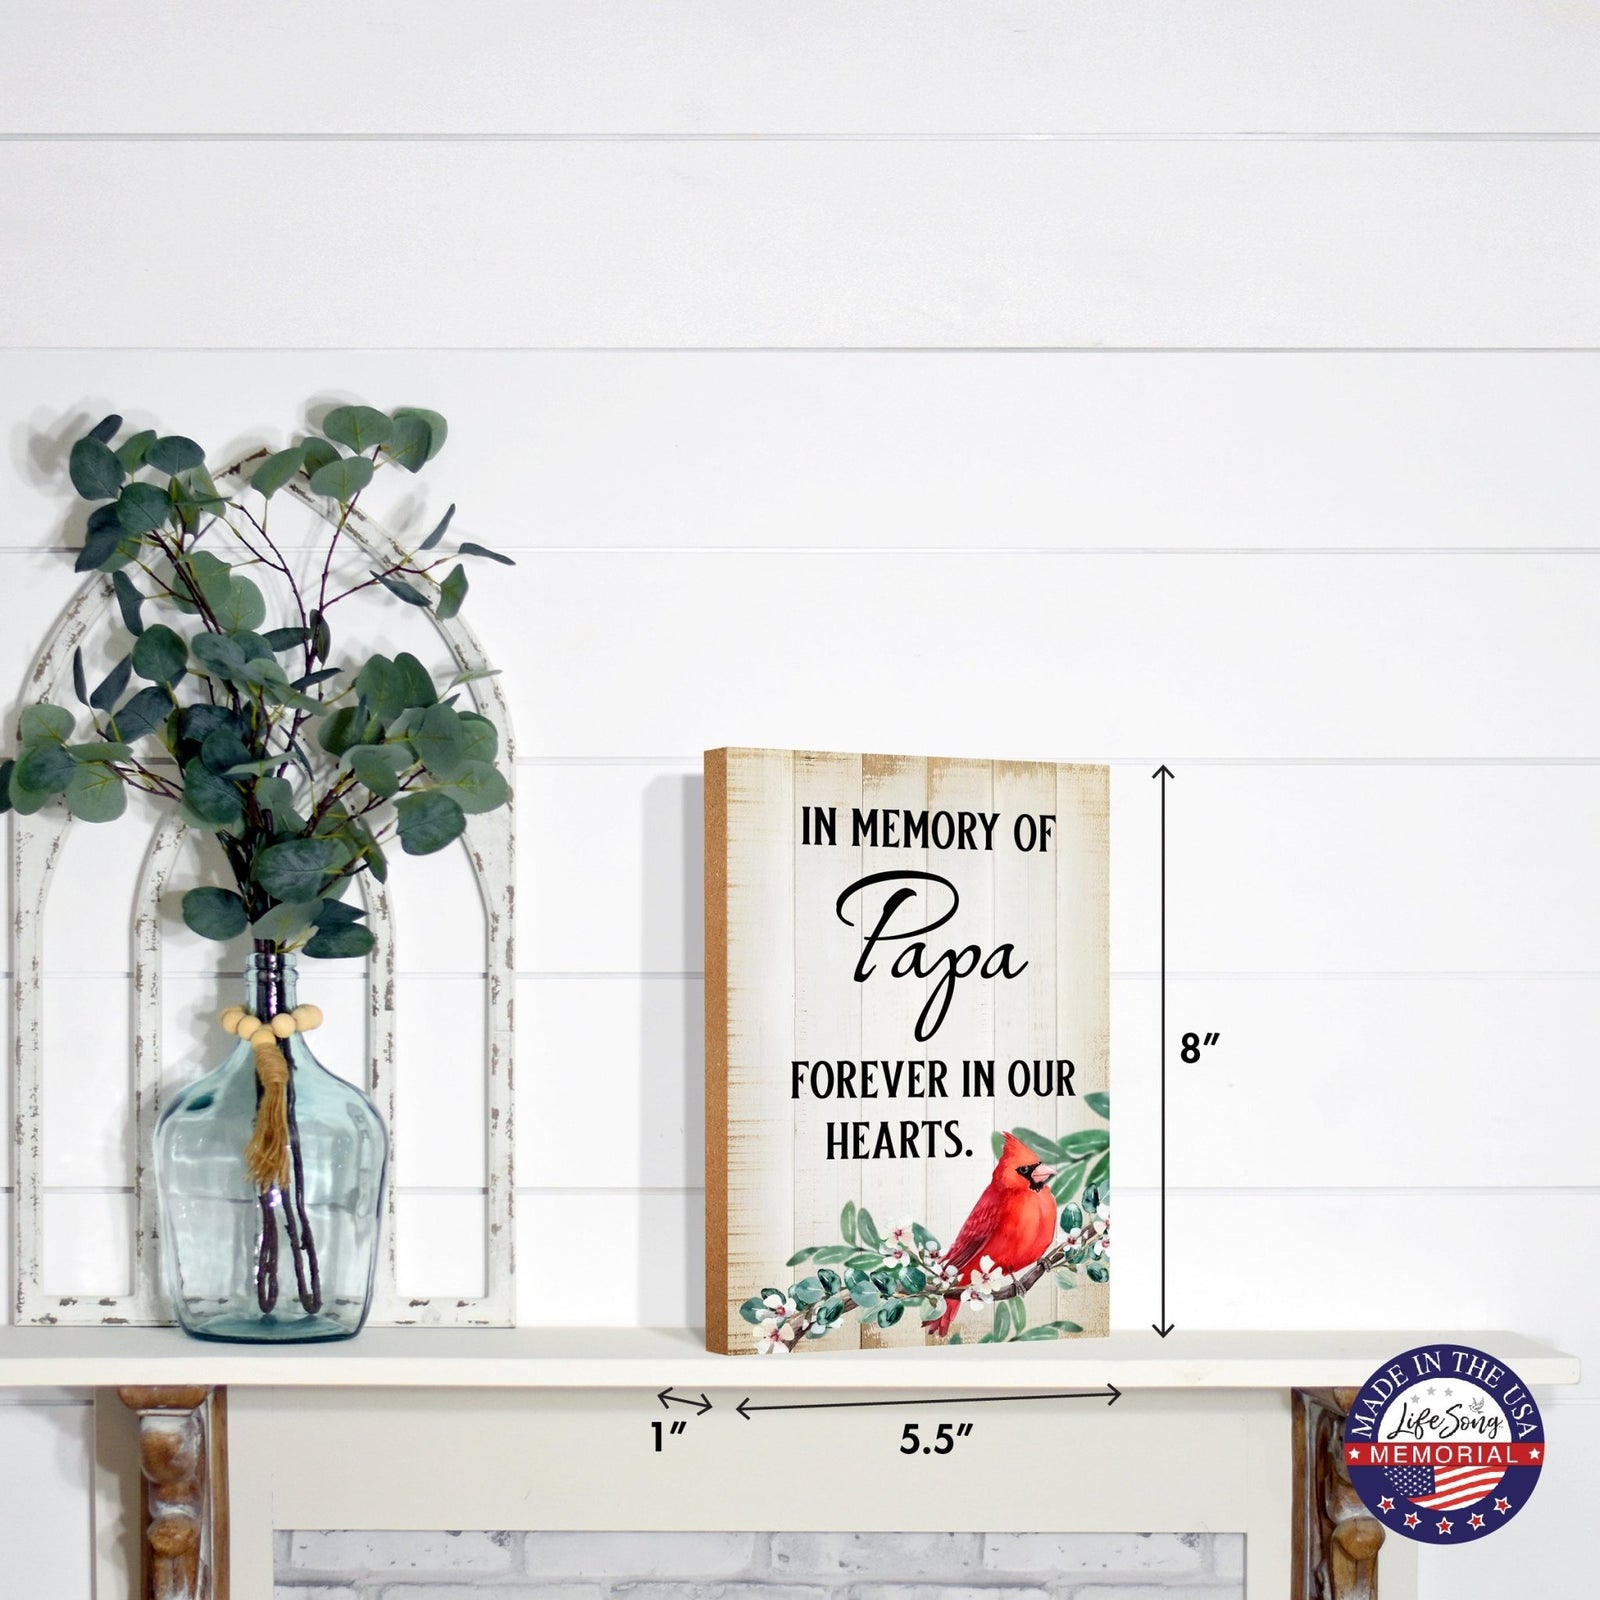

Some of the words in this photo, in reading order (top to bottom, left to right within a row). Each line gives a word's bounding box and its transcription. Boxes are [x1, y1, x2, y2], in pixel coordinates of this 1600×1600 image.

[801, 806, 837, 846] IN
[851, 807, 1001, 851] MEMORY
[1013, 813, 1057, 853] OF
[835, 869, 1029, 1043] Papa
[791, 1060, 949, 1099] FOREVER
[962, 1059, 995, 1098] IN
[1007, 1059, 1076, 1098] OUR
[826, 1119, 973, 1160] HEARTS.
